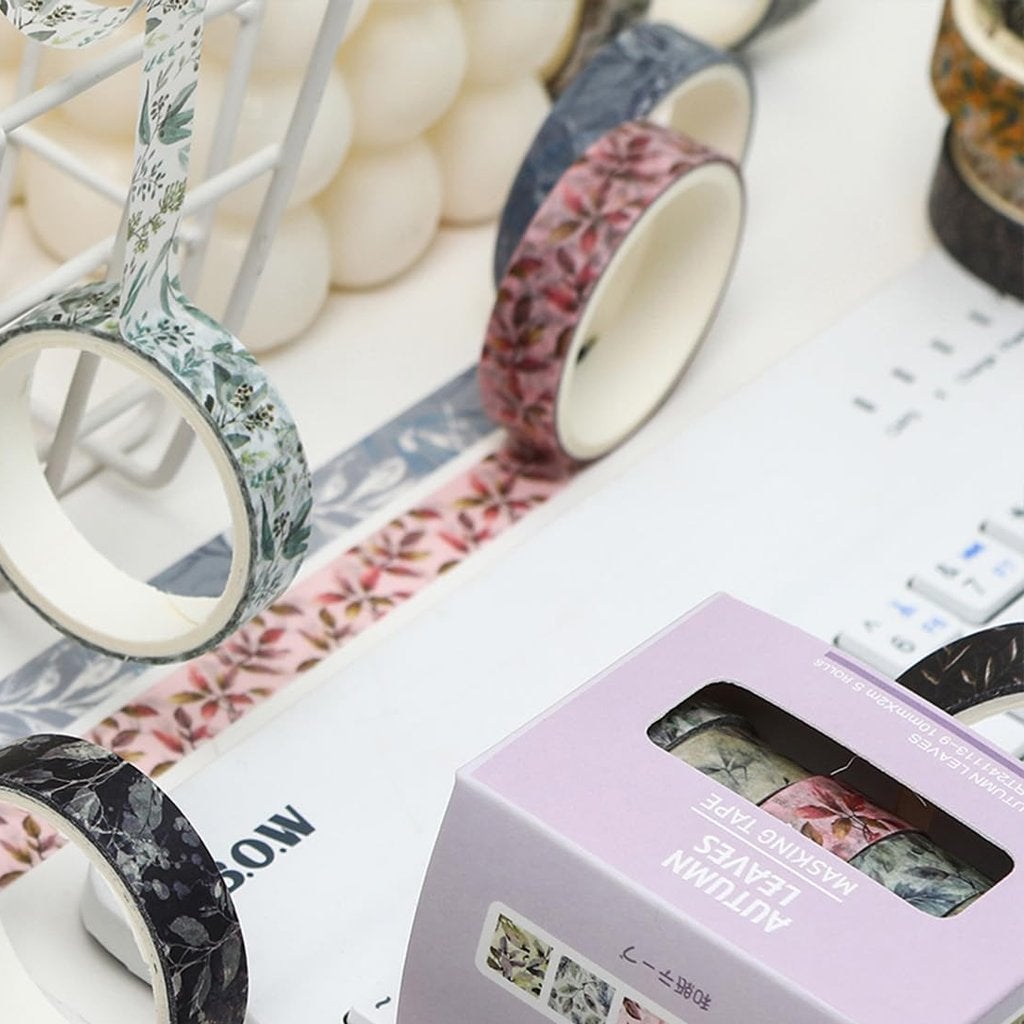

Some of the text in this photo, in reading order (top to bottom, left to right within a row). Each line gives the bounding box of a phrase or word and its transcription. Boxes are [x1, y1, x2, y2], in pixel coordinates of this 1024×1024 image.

[852, 682, 864, 692] 5
[908, 732, 1024, 813] UTUMN LEAVES
[692, 834, 802, 907] LEAVES
[699, 792, 859, 897] MASKING TAPE
[661, 849, 793, 934] AUTUMN
